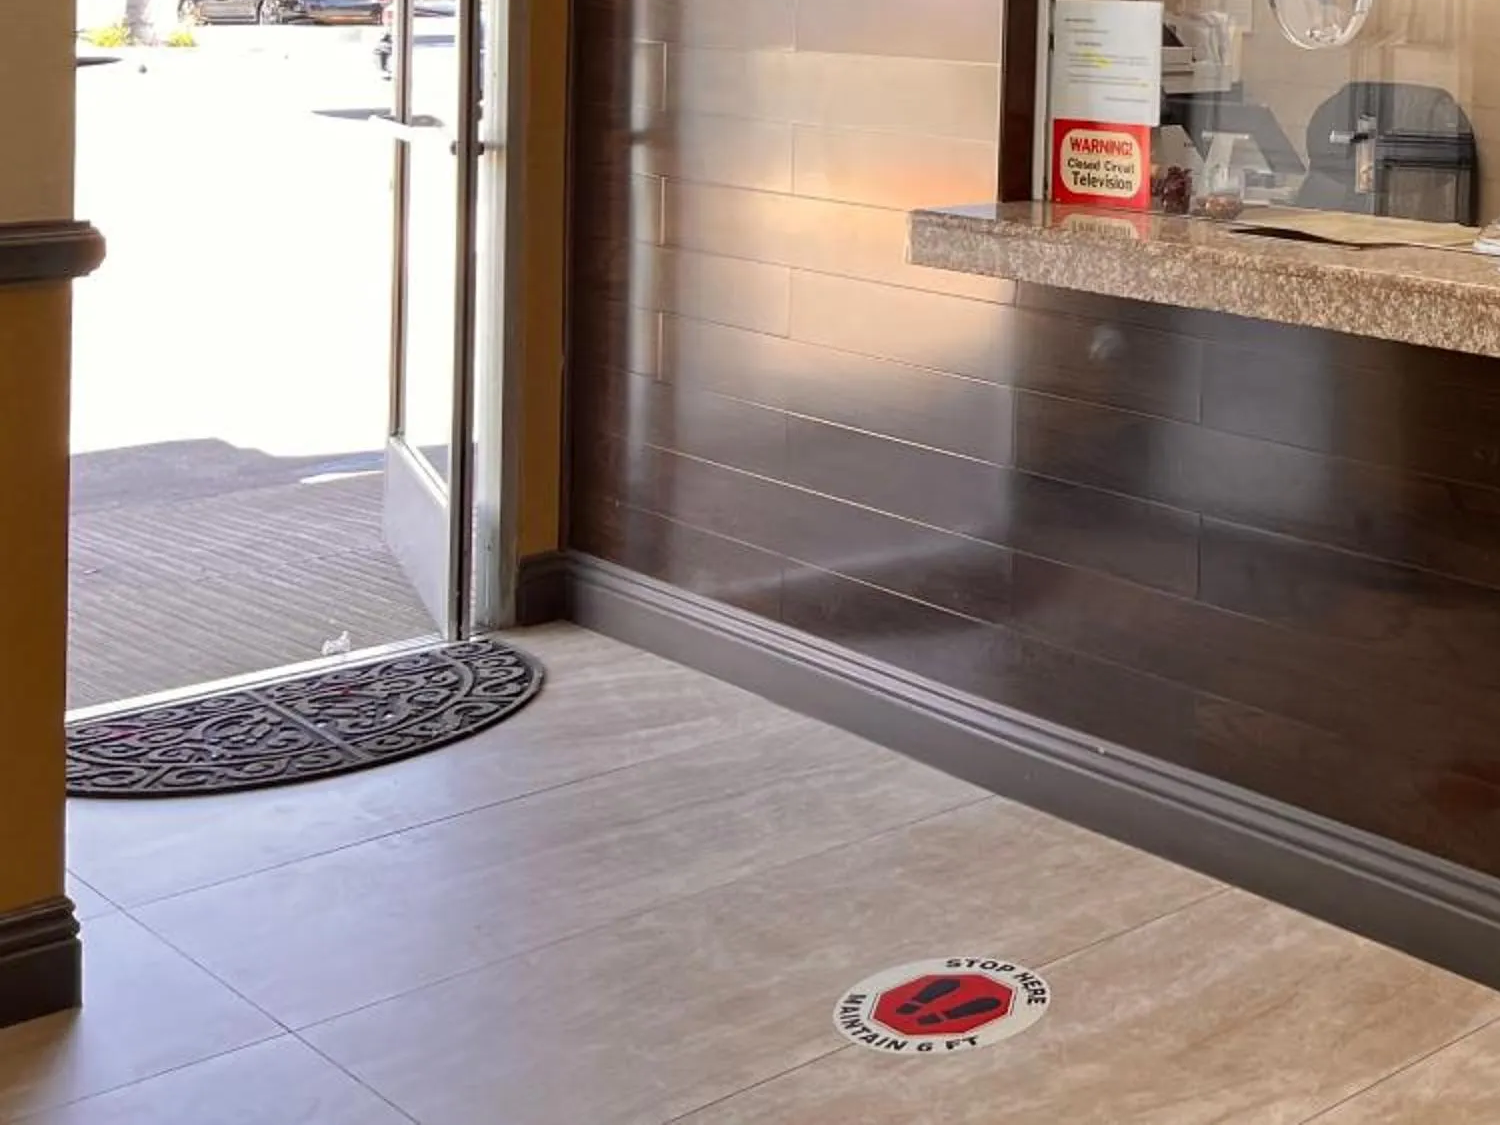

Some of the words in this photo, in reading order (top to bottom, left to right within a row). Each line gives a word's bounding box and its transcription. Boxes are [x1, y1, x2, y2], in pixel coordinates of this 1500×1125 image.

[1069, 137, 1133, 156] WARNING!
[1071, 171, 1132, 191] Television
[946, 958, 1016, 973] STOP
[1014, 972, 1047, 1006] HERE
[840, 994, 909, 1052] MAINTAIN
[917, 1042, 933, 1052] 6
[945, 1035, 980, 1050] FT
